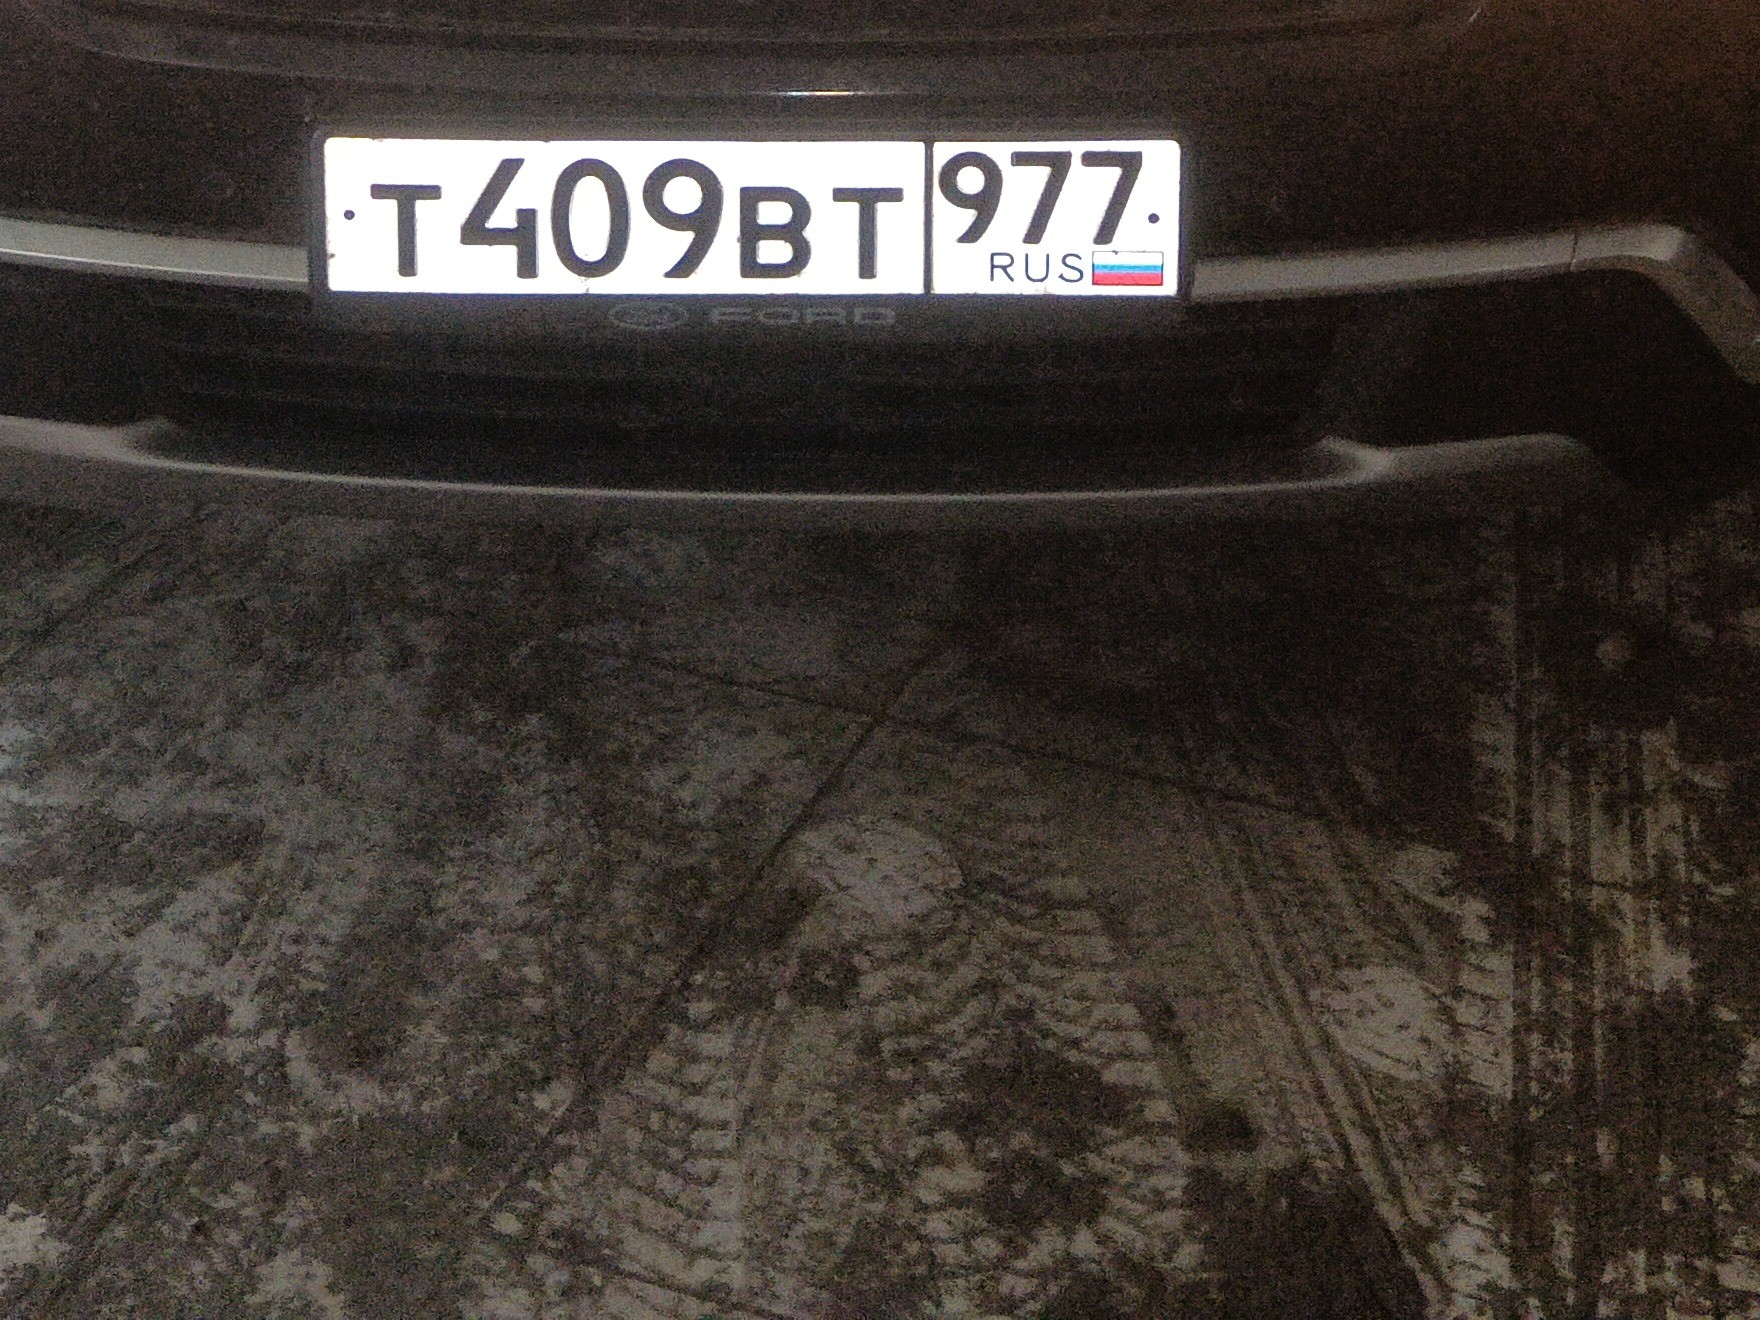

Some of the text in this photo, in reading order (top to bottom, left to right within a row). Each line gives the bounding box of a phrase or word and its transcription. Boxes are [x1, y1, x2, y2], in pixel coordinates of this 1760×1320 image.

[937, 150, 1144, 245] 977
[989, 251, 1086, 283] RUS
[710, 306, 896, 325] FORD
